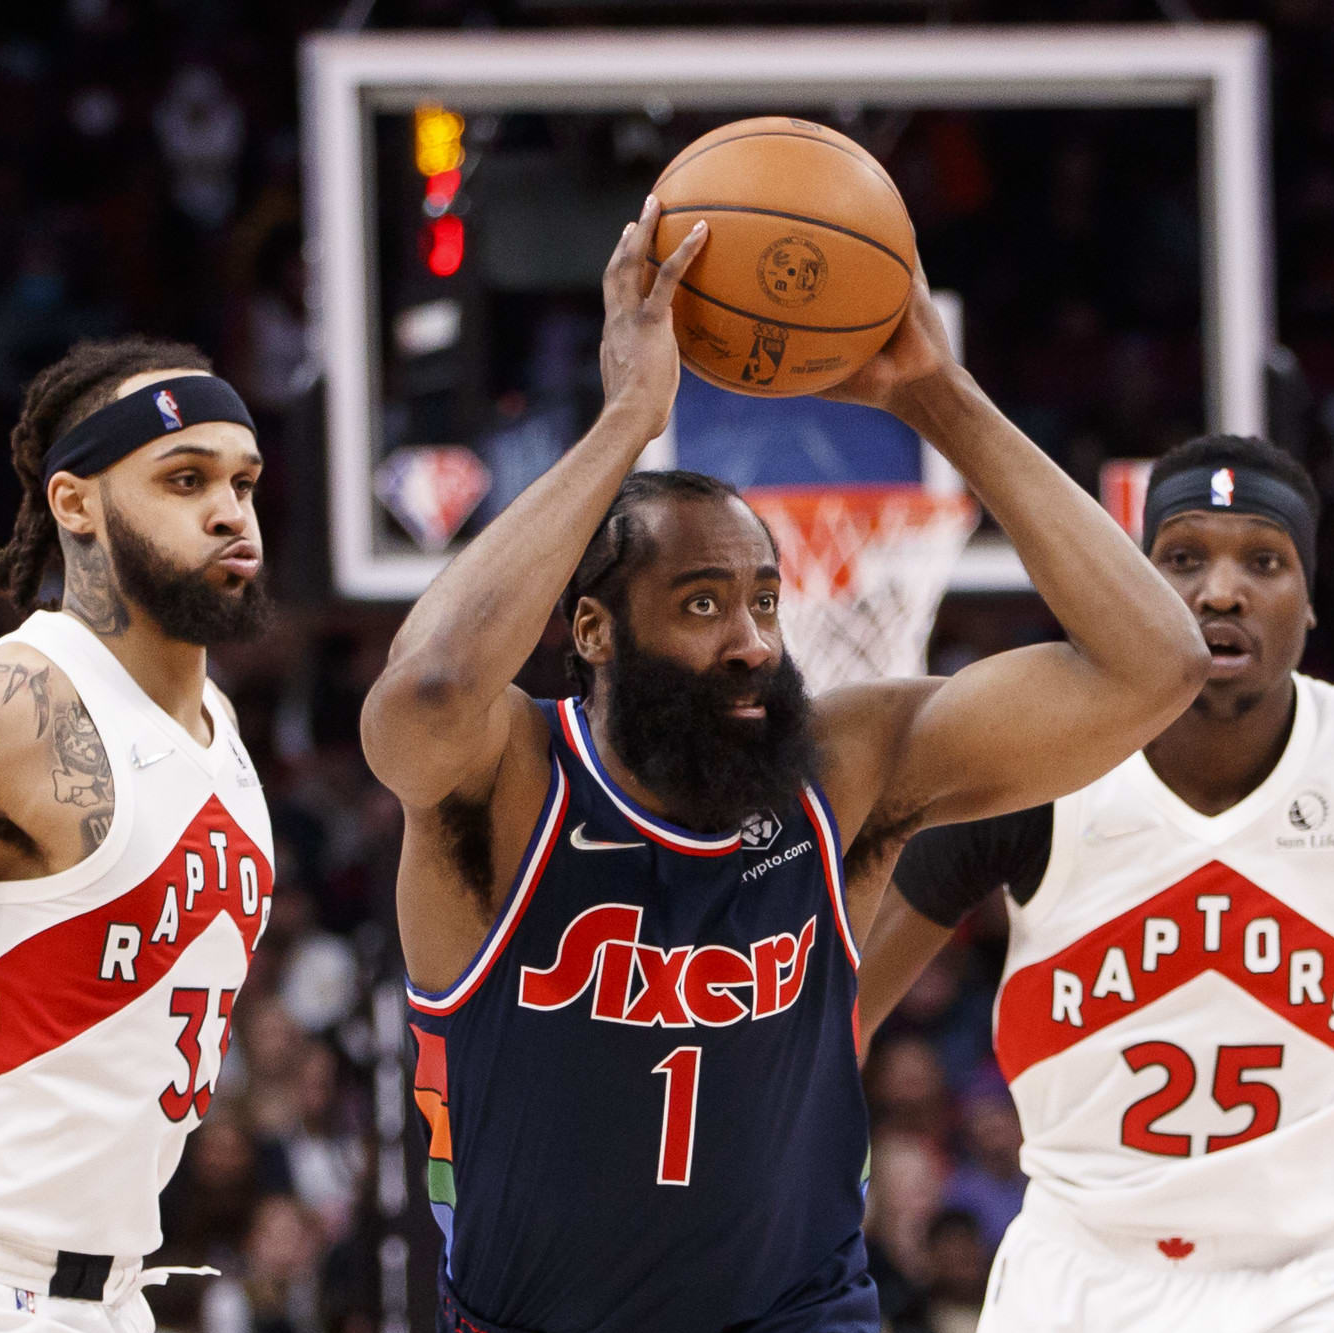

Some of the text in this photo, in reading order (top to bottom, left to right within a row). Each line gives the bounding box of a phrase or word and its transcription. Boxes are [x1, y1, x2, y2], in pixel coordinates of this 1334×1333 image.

[740, 840, 813, 883] rypto.com
[518, 903, 817, 1028] Sixers
[651, 1046, 703, 1187] 1
[1120, 1040, 1285, 1158] 25
